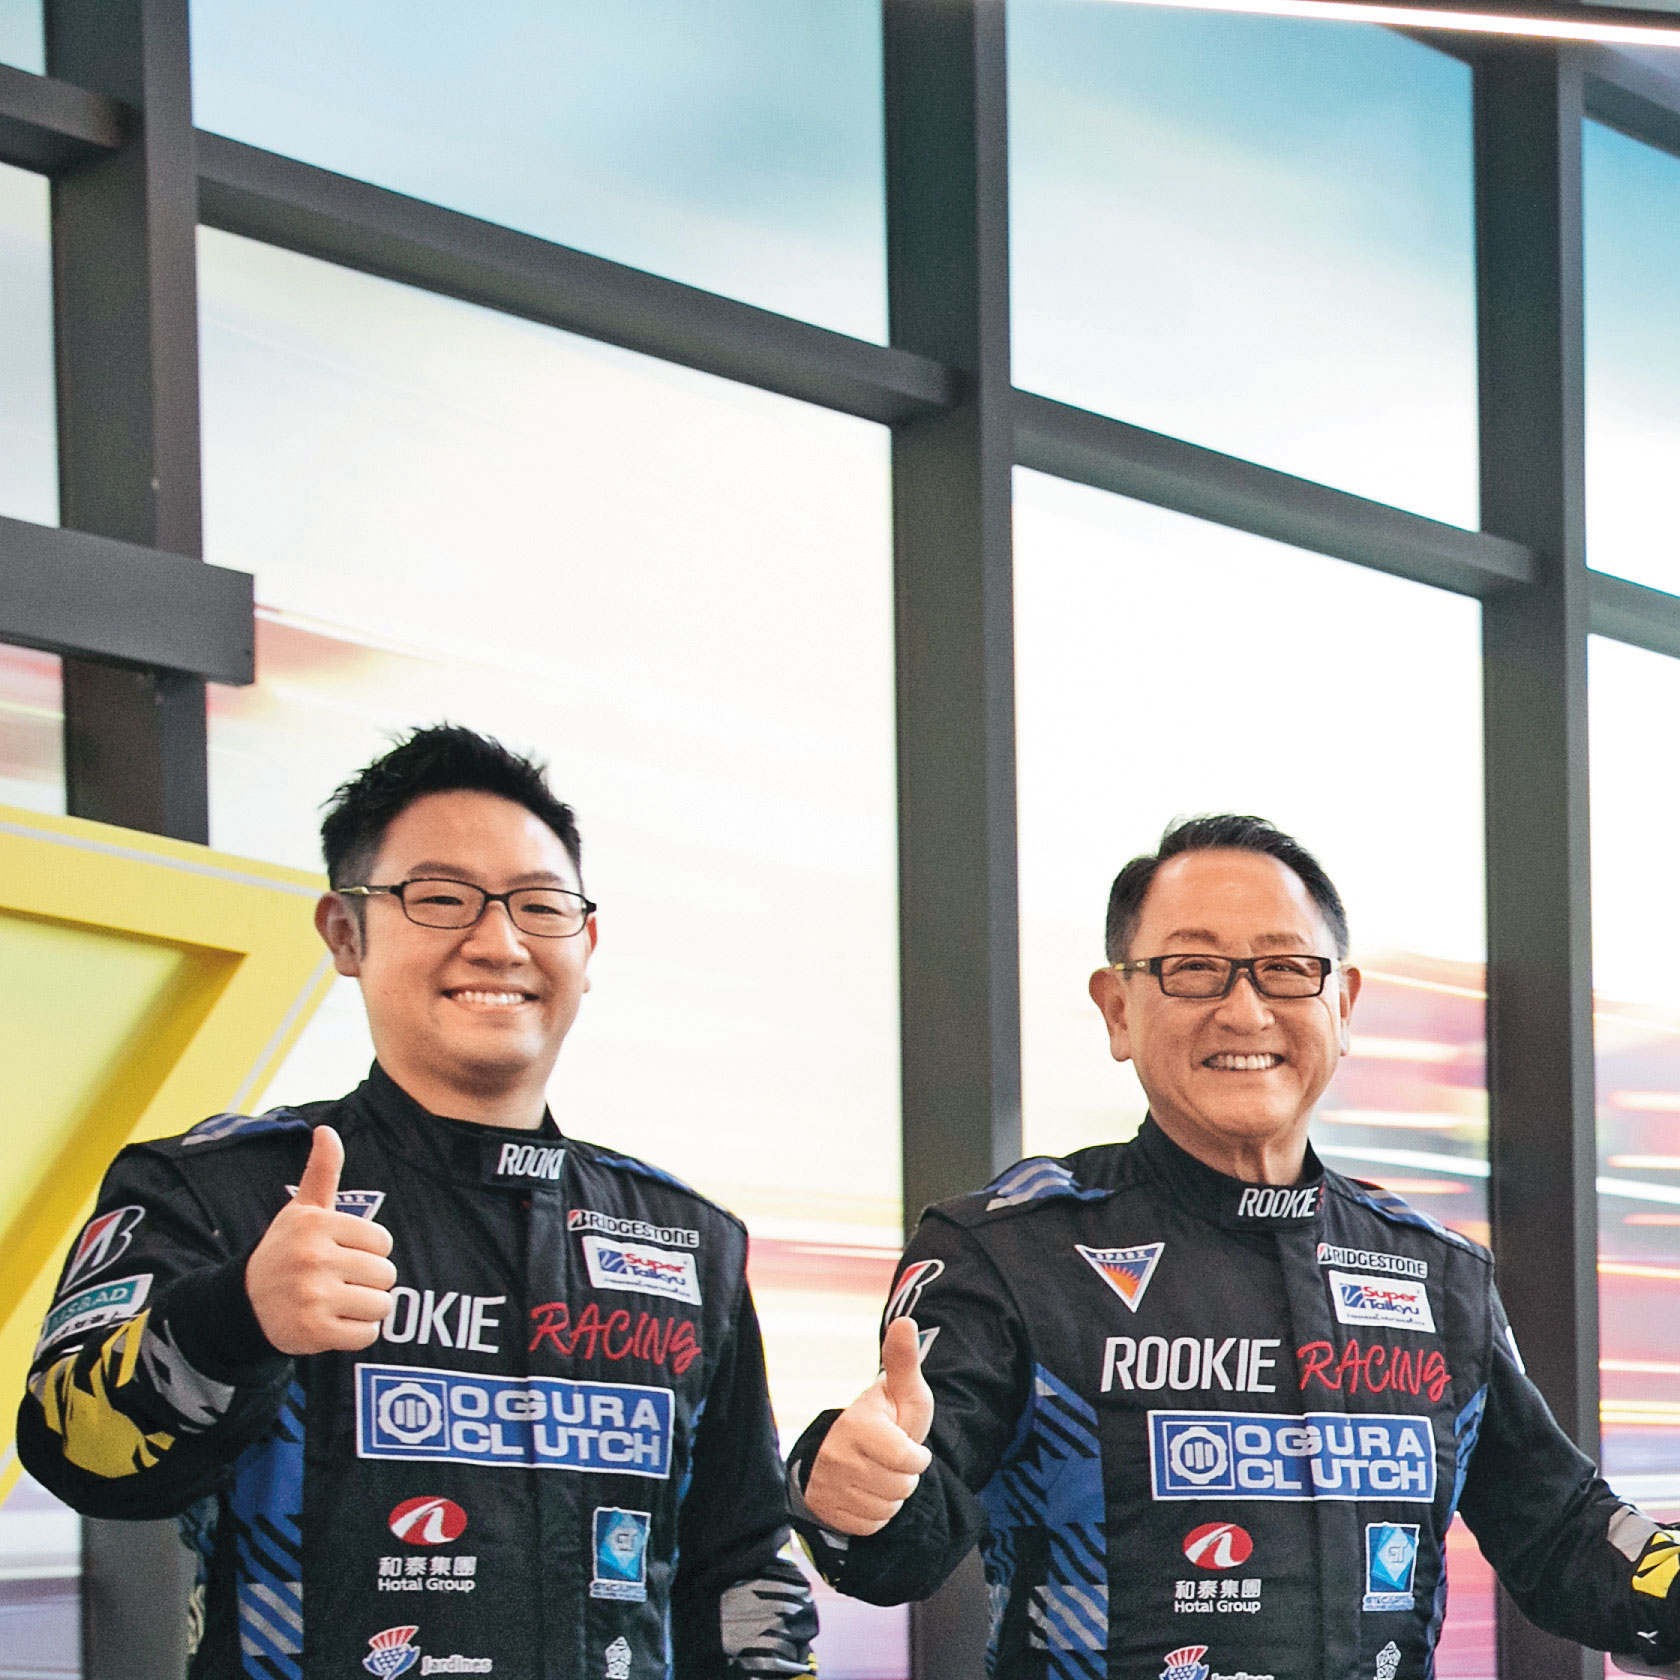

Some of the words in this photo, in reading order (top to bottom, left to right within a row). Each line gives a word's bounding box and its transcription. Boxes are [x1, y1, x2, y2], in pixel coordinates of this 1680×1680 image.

[497, 1143, 567, 1180] ROOKI
[1237, 1186, 1319, 1219] ROOKIE
[568, 1209, 697, 1247] BRIDGESTONE
[623, 1252, 685, 1273] Super
[1318, 1244, 1427, 1276] BRIDGESTONE
[1362, 1286, 1419, 1303] Super
[380, 1286, 506, 1354] OKIE
[527, 1301, 702, 1375] RACING
[1100, 1335, 1281, 1394] ROOKIE
[1296, 1338, 1452, 1402] RACING
[448, 1384, 661, 1433] OGURA
[449, 1421, 661, 1468] CLUTCH
[1234, 1423, 1426, 1460] OGURA
[1236, 1457, 1427, 1493] CLUTCH
[377, 1577, 422, 1592] Hotai
[425, 1578, 476, 1594] Group
[1174, 1599, 1214, 1614] Hotai
[1216, 1600, 1262, 1615] Group
[420, 1653, 493, 1676] Jardines
